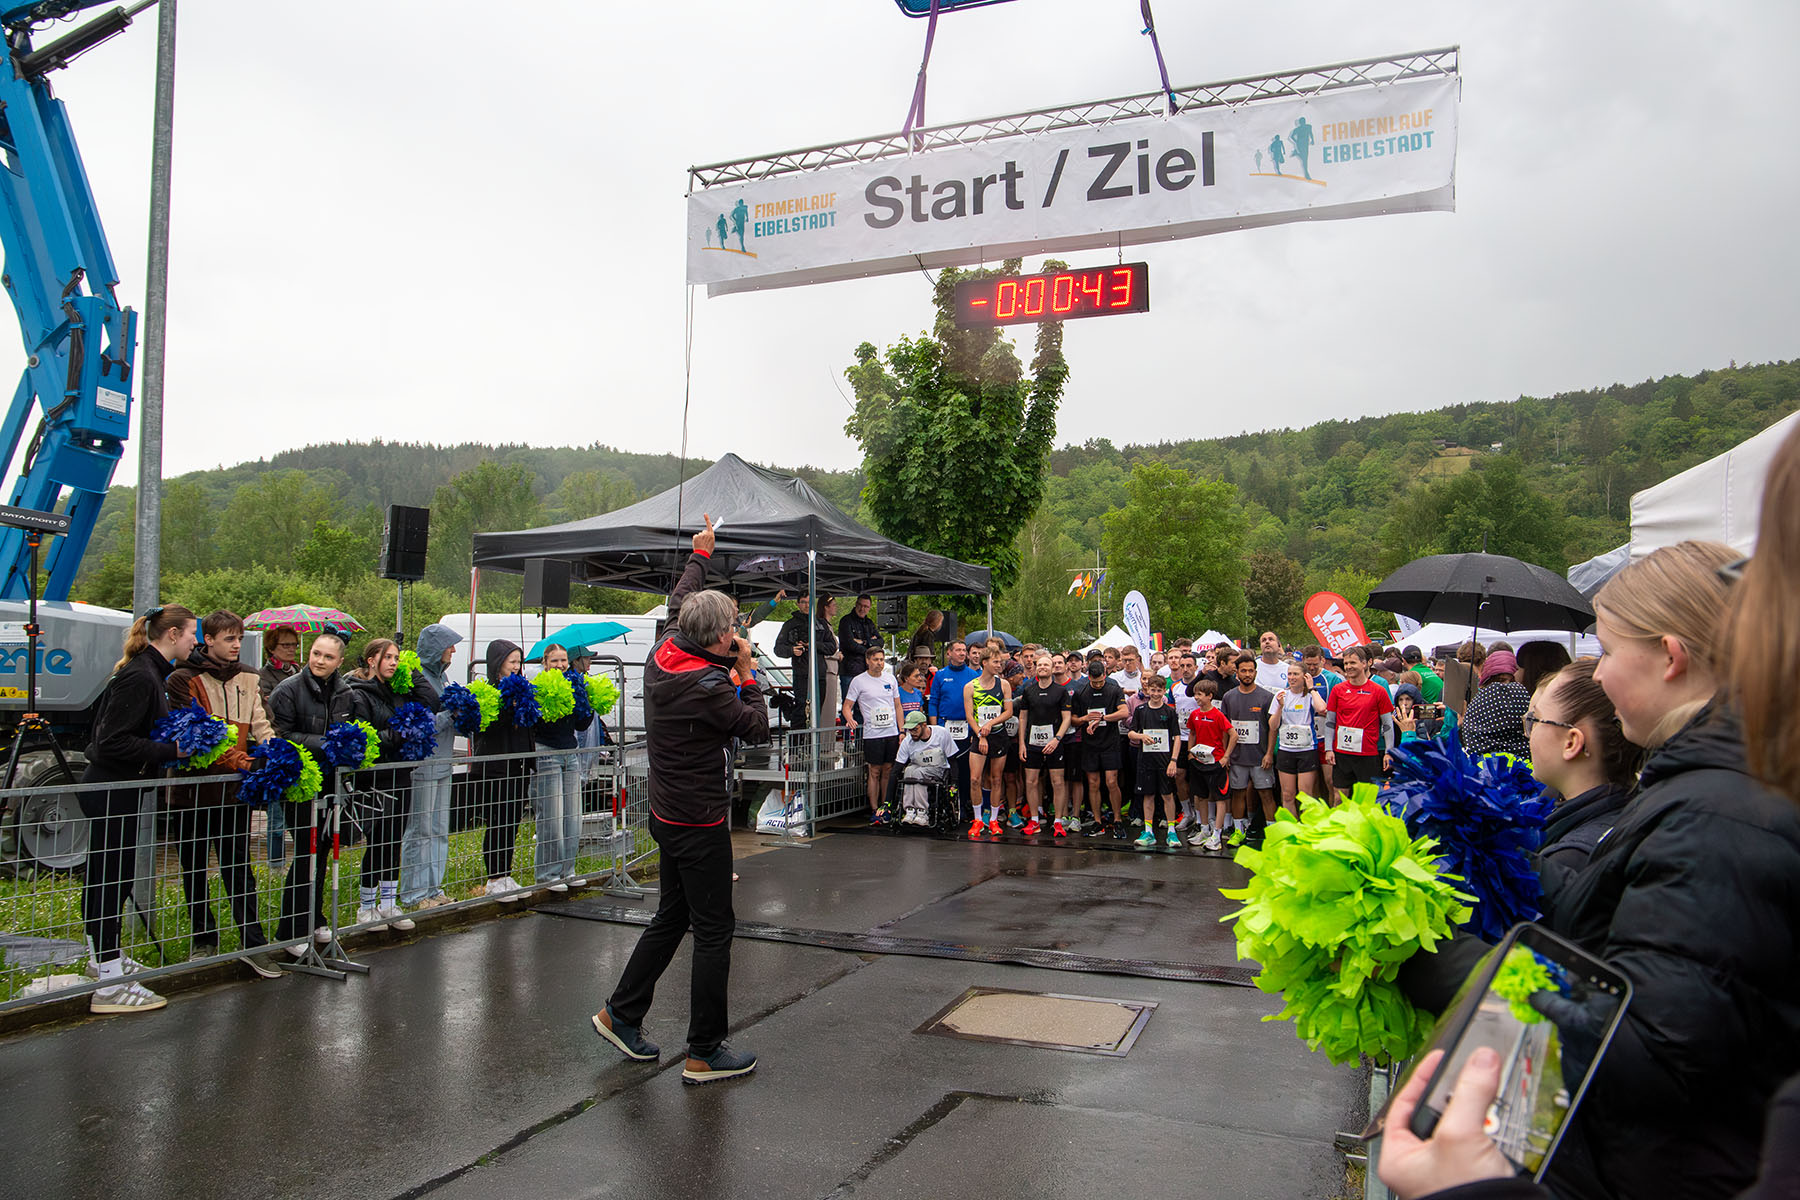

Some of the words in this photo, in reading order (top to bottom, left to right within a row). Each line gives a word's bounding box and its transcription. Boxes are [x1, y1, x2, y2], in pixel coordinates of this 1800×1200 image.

[1322, 108, 1433, 142] FIRMENLAUF
[1323, 130, 1435, 164] EIBELSTADT
[864, 160, 1025, 229] Start
[1042, 148, 1070, 208] /
[1087, 130, 1215, 201] Ziel
[754, 192, 837, 219] FIRMENLAUF
[754, 211, 837, 238] EIBELSTADT
[1, 511, 58, 525] DATASPORT
[875, 713, 889, 721] 1337
[1033, 732, 1049, 740] 1053
[1286, 732, 1299, 740] 393
[1344, 735, 1352, 743] 24
[765, 819, 795, 828] ACTI
